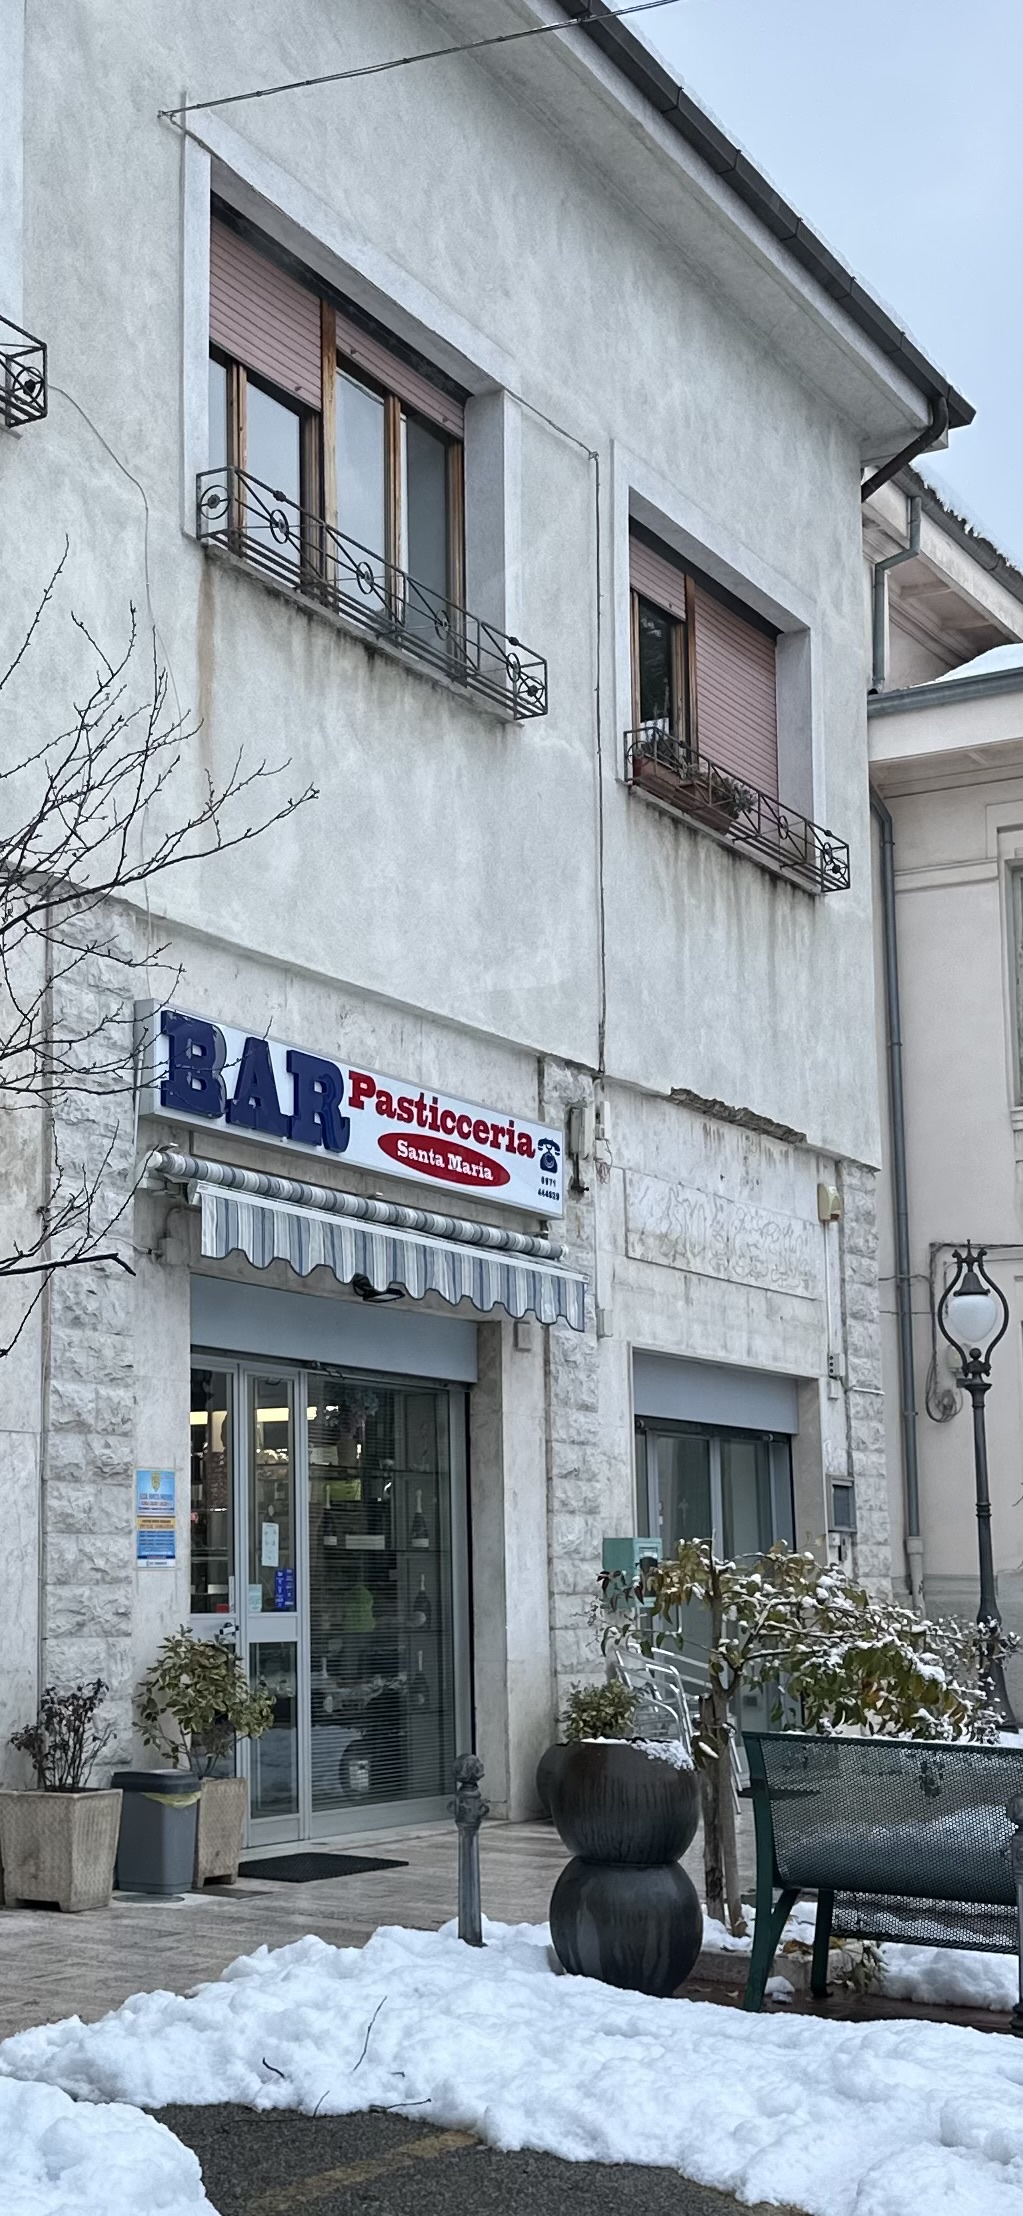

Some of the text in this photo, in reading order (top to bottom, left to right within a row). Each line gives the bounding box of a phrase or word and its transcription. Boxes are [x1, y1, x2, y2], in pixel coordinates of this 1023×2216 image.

[161, 1009, 351, 1153] BAR
[348, 1070, 536, 1159] Pasticceria
[397, 1139, 494, 1181] Santa Maria
